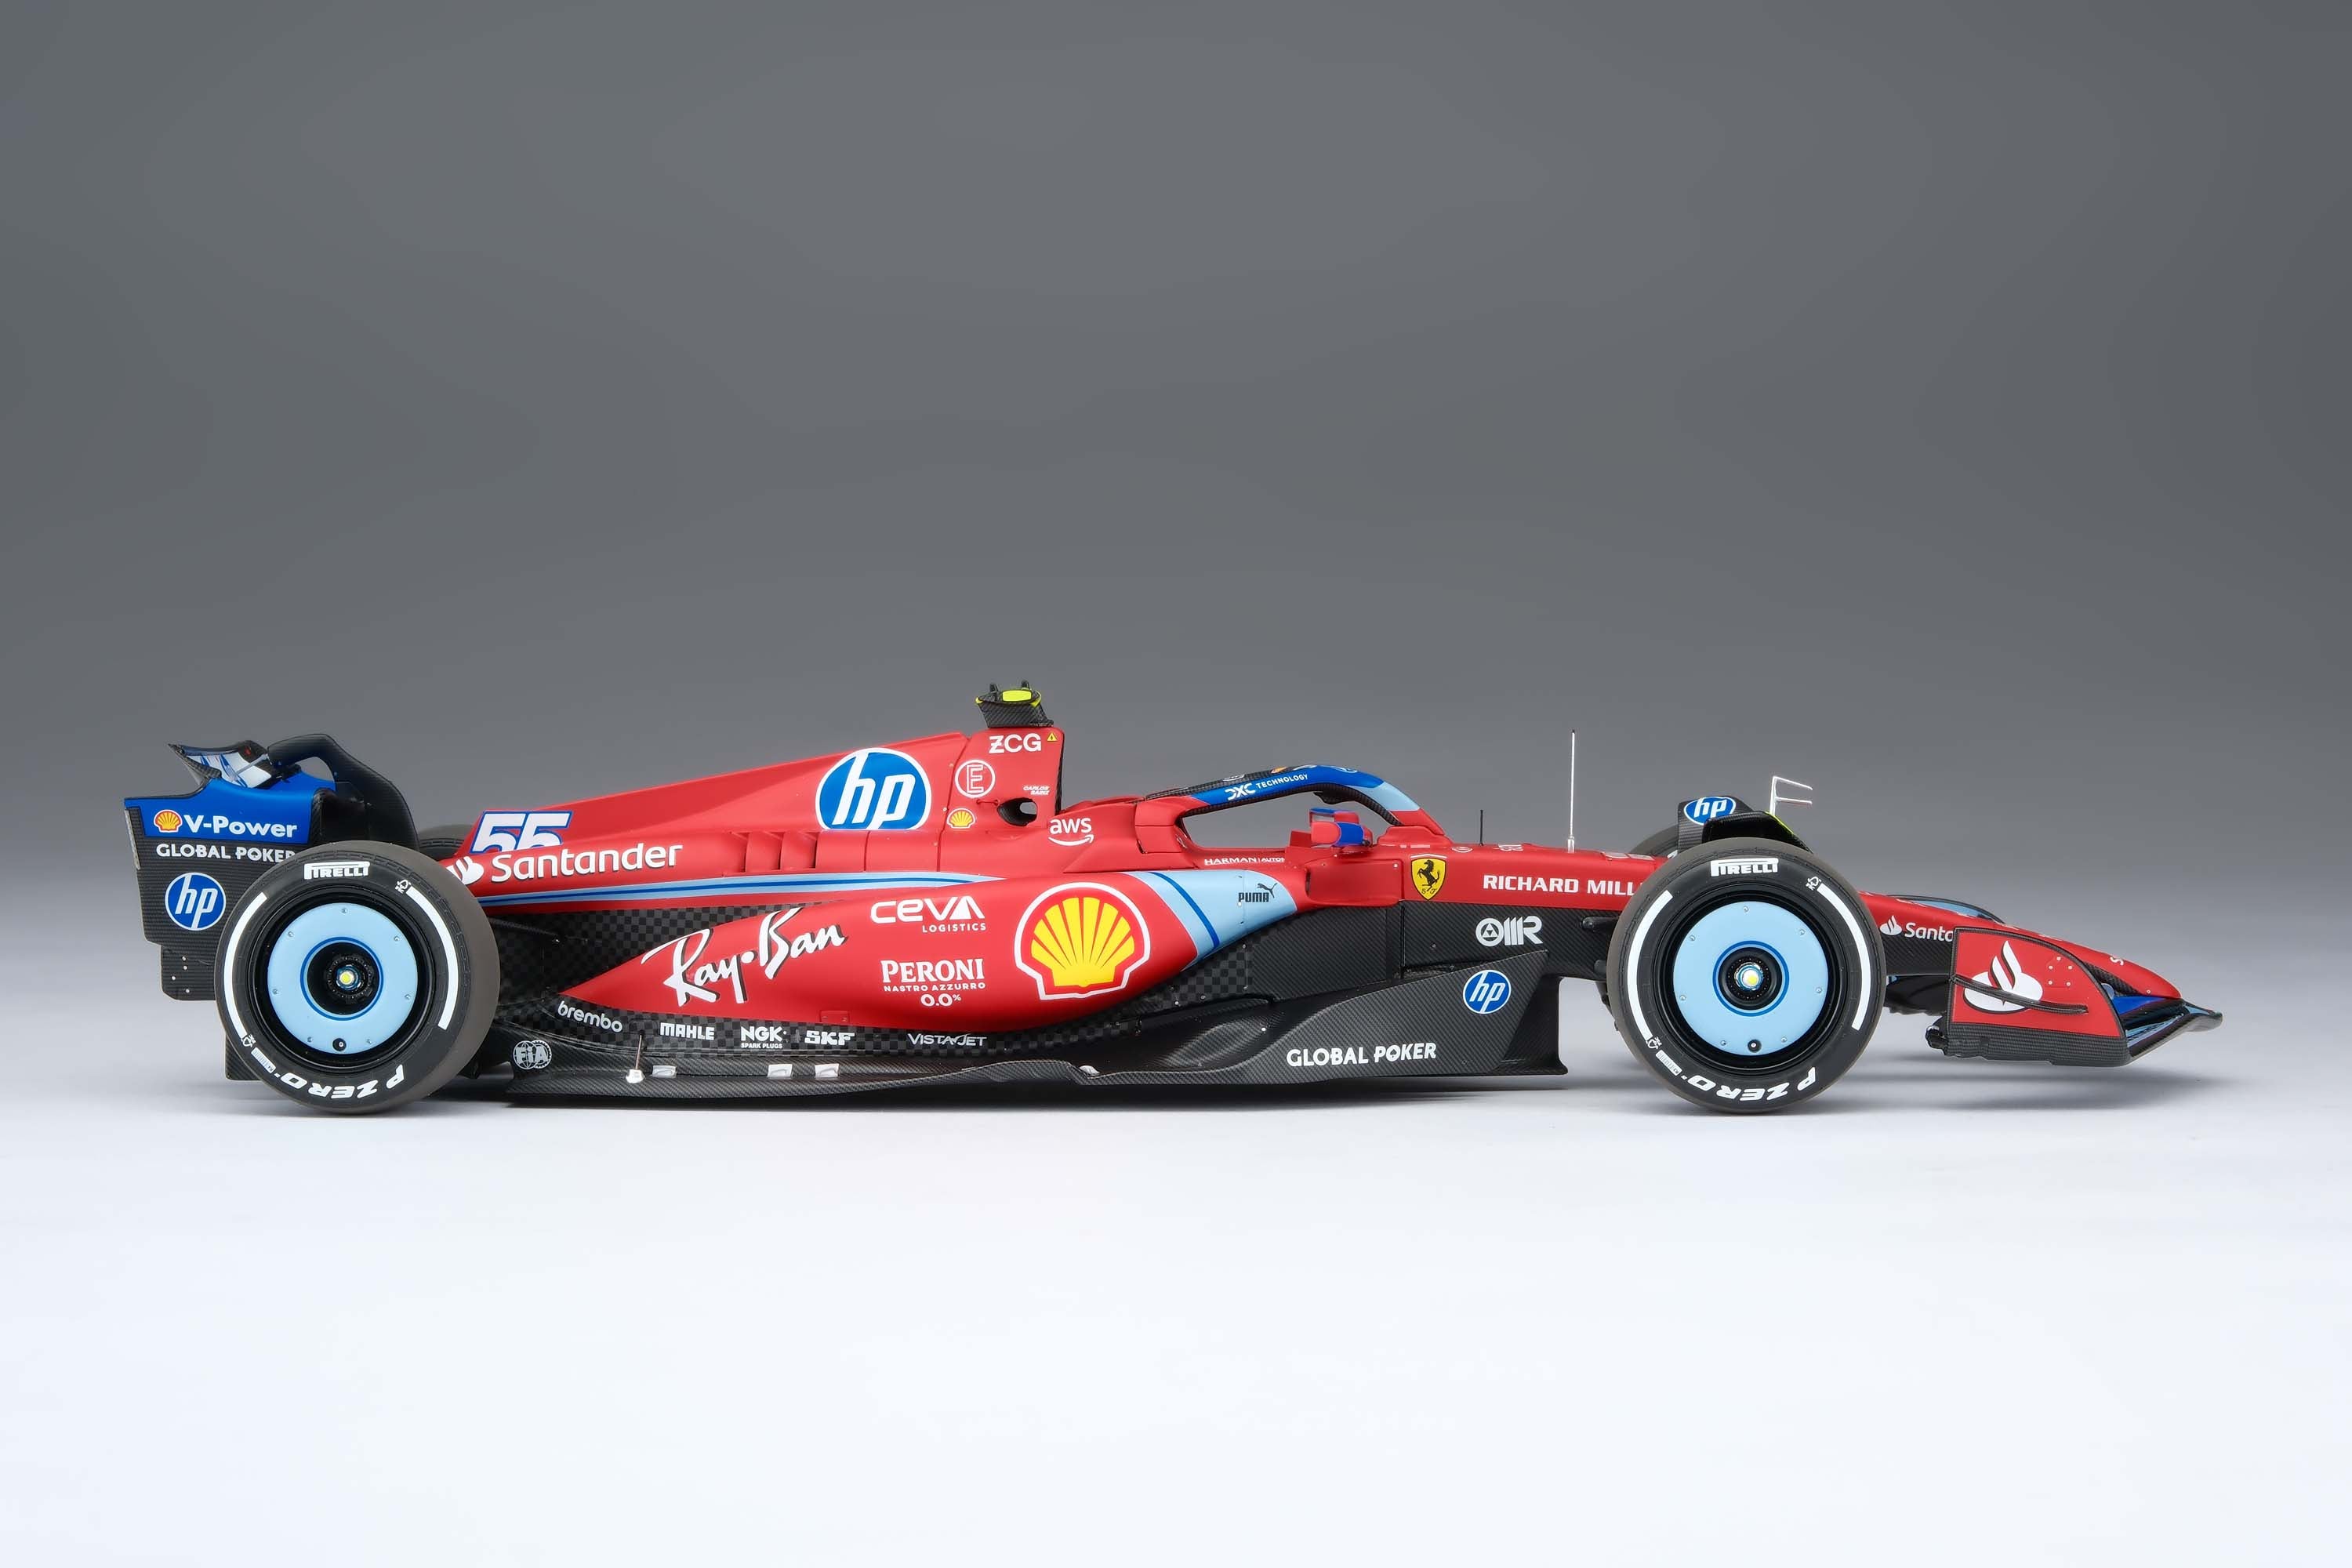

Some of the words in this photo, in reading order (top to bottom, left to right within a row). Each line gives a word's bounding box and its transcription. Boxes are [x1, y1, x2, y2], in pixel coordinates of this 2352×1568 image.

[833, 750, 916, 830] hp
[1225, 783, 1256, 800] DXC
[1256, 773, 1308, 789] TECHNOLOGY
[183, 815, 298, 838] V-Power
[1049, 818, 1092, 835] aws
[156, 844, 231, 859] GLOBAL
[1203, 856, 1258, 866] HARMAN
[303, 861, 370, 880] PIRELLI
[491, 843, 683, 883] Santander
[1710, 858, 1779, 877] PIRELLI
[1483, 874, 1579, 893] RICHARD
[1588, 879, 1643, 896] MILL
[175, 873, 218, 930] hp
[1238, 892, 1269, 902] PUMA
[922, 923, 986, 933] LOGISTICS
[880, 958, 985, 983] PERONI
[931, 982, 986, 991] AZZURRO
[1468, 970, 1506, 1014] hp
[920, 993, 961, 1007] 0.0%
[557, 1000, 623, 1033] brembo
[659, 1022, 715, 1040] MAHLE
[740, 1025, 783, 1042] NGK
[804, 1029, 855, 1046] SKF
[1286, 1047, 1368, 1067] GLOBAL
[1374, 1042, 1437, 1063] POKER
[386, 1064, 405, 1089] P
[1797, 1067, 1817, 1091] P
